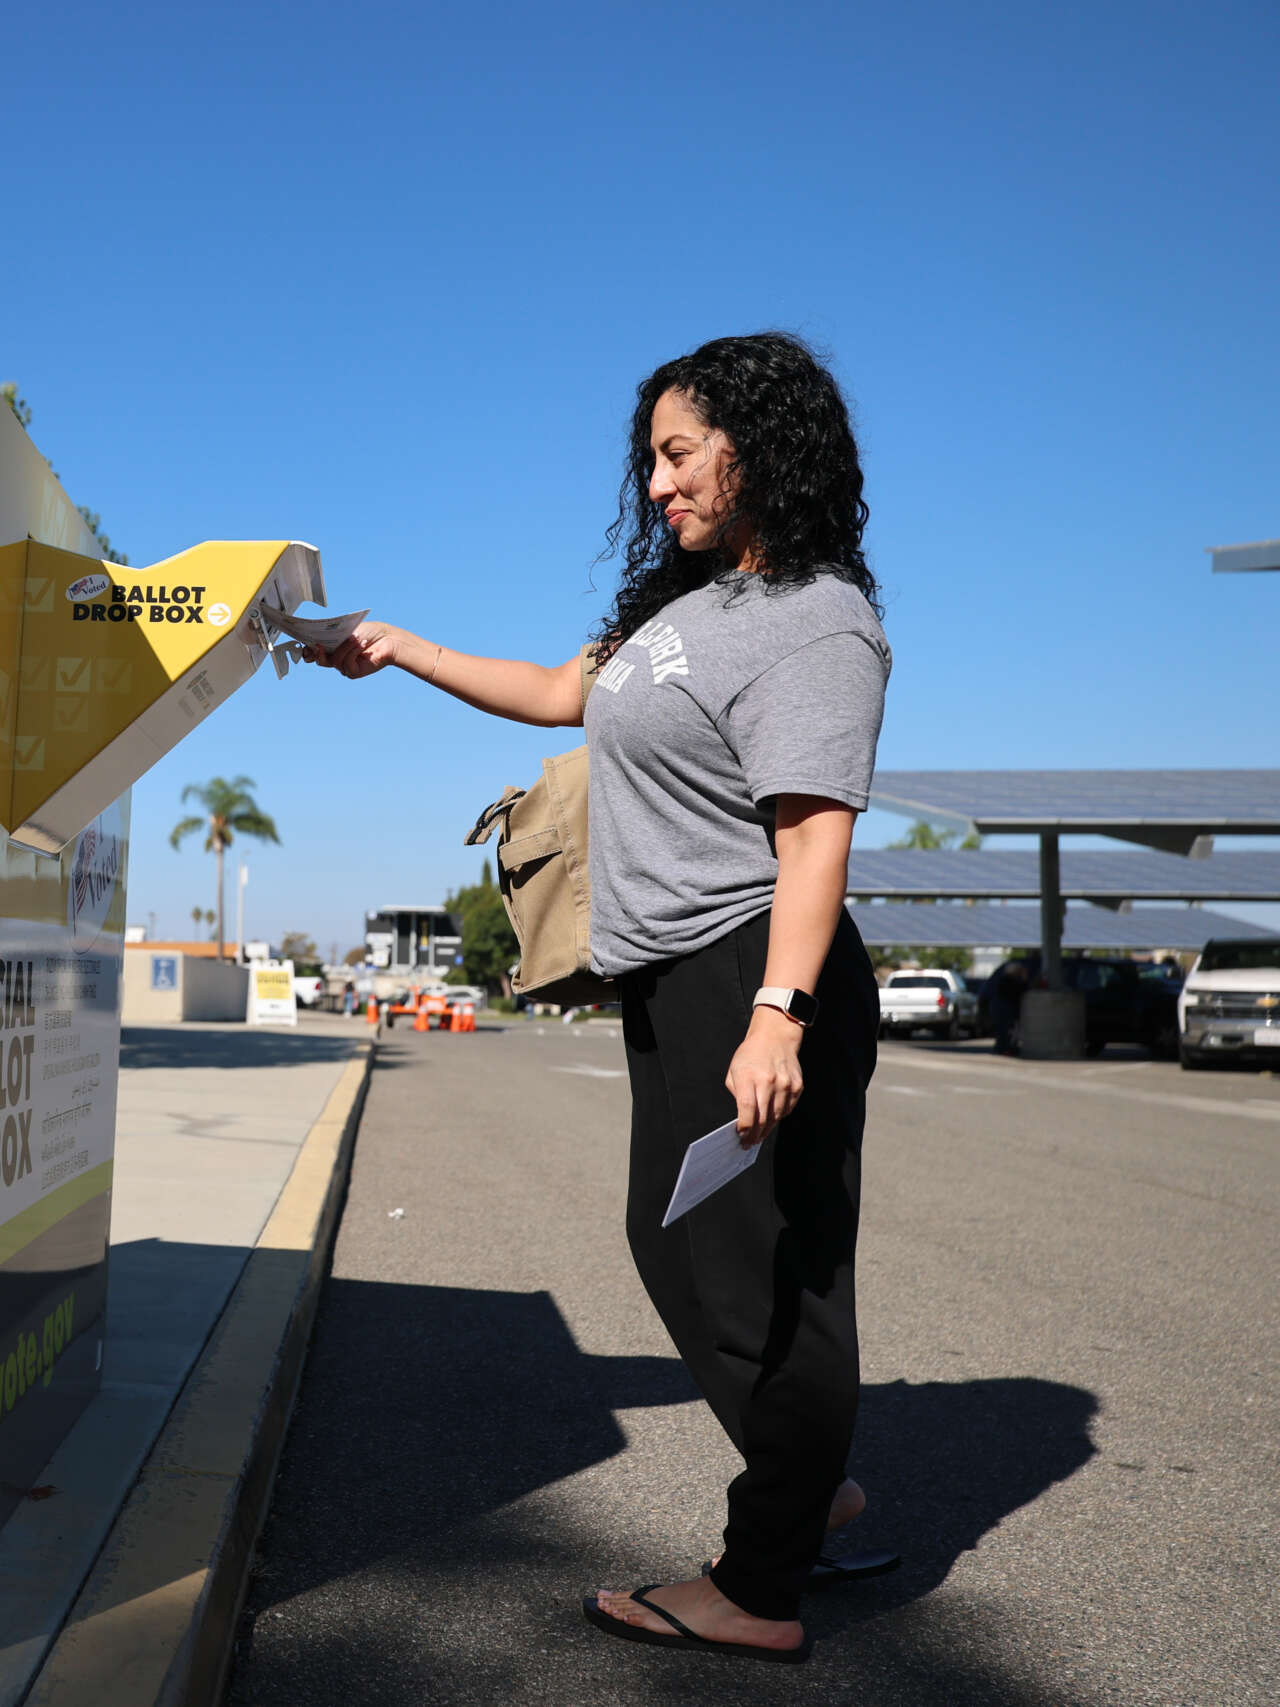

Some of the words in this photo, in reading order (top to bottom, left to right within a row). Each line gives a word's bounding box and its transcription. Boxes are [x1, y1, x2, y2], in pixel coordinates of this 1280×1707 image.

[81, 581, 106, 595] Voted
[112, 585, 205, 603] BALLOT
[73, 604, 142, 622] DROP
[150, 605, 204, 623] BOX
[87, 834, 117, 910] Voted
